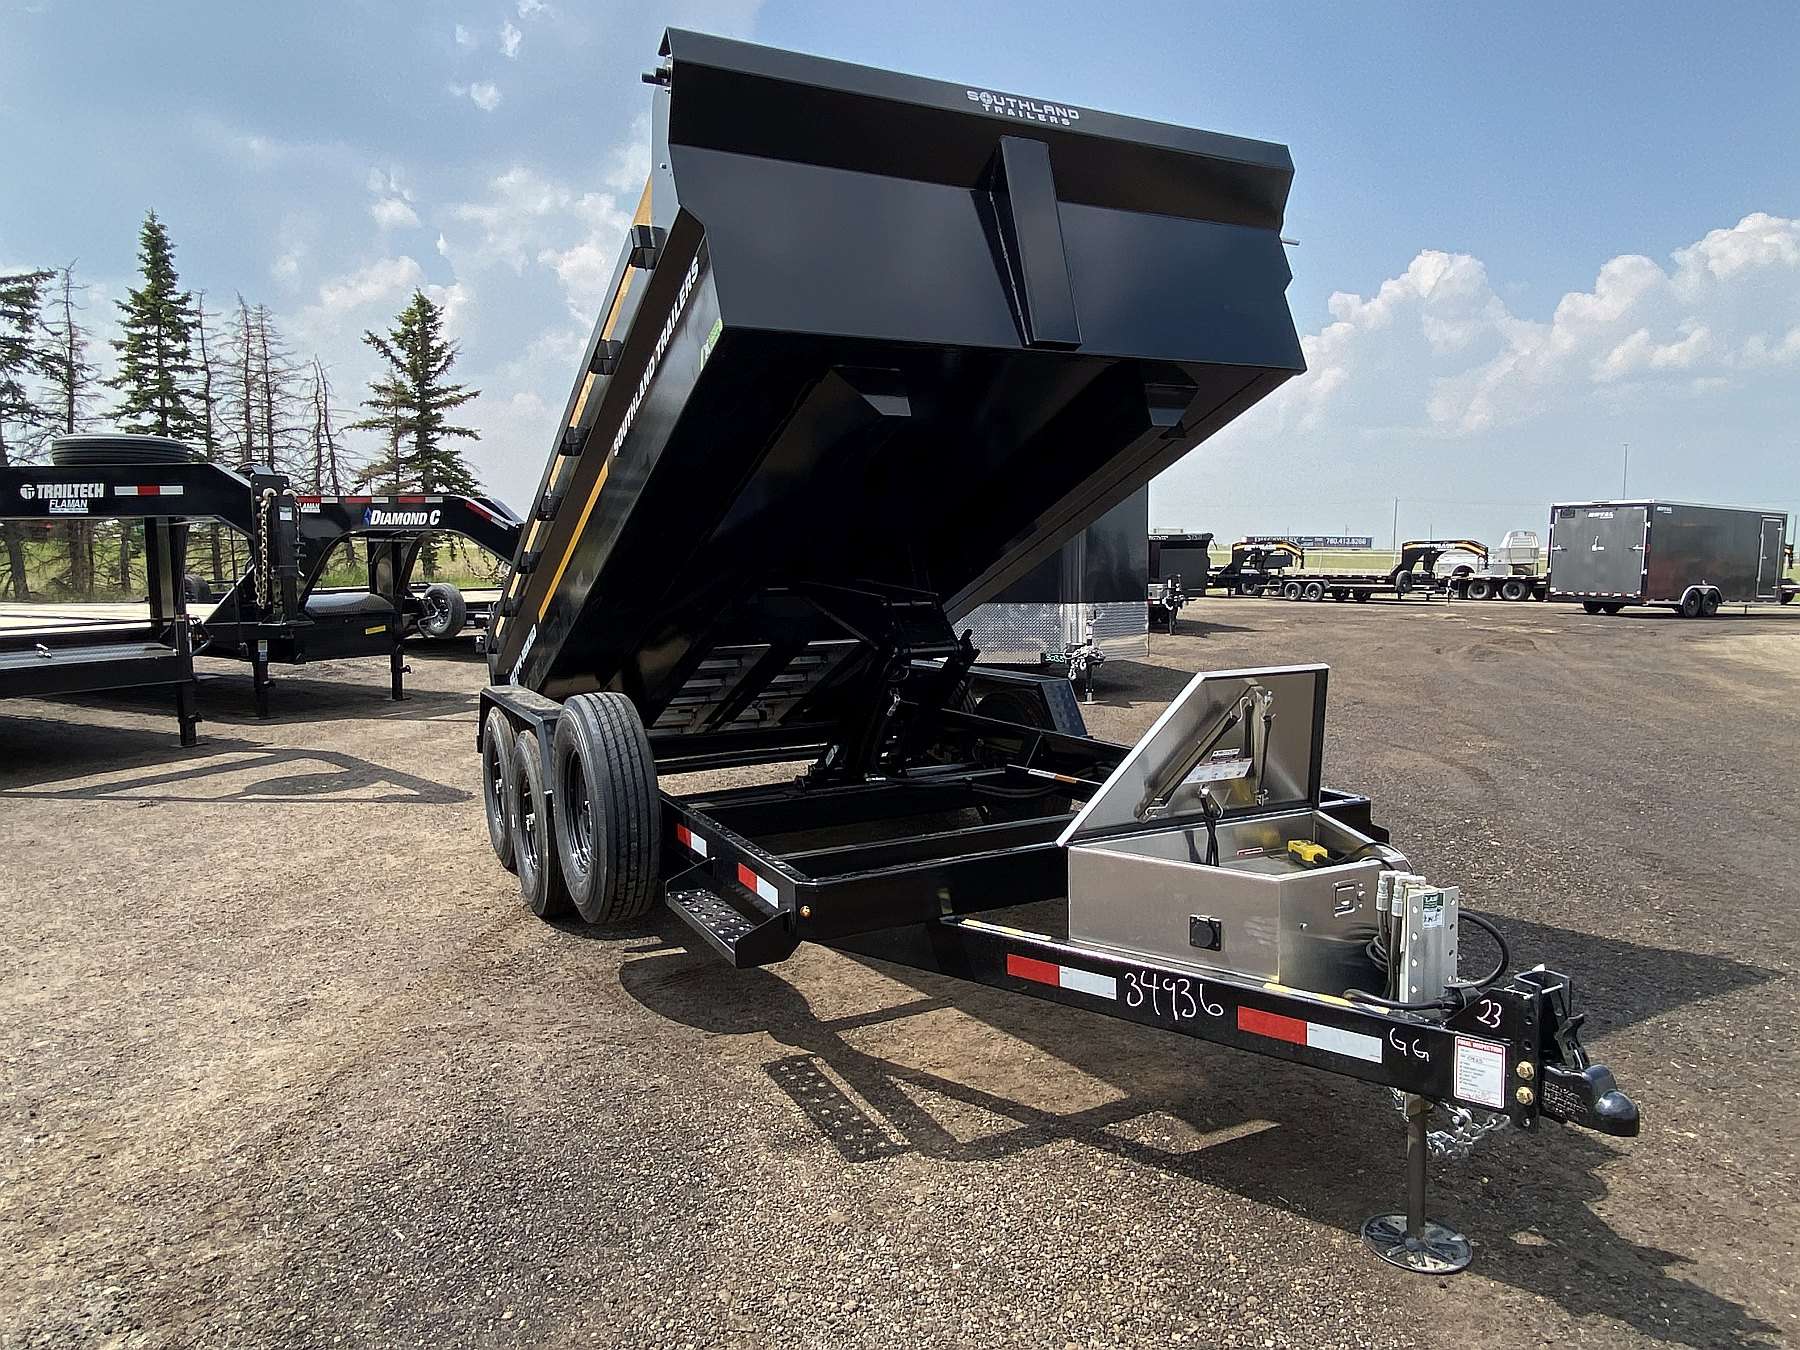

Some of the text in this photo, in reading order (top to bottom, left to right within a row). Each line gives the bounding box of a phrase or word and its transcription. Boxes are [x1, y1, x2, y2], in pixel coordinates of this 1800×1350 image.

[966, 90, 1080, 120] SOUTHLAND
[982, 103, 1071, 126] TRAILERS
[613, 256, 700, 457] SOUTHLAND TRAILERS
[36, 483, 105, 499] TRAILTECH
[49, 499, 88, 508] FLAMAN
[370, 509, 441, 526] DIAMOND C
[1124, 970, 1224, 1021] 34936
[1476, 999, 1502, 1029] 23
